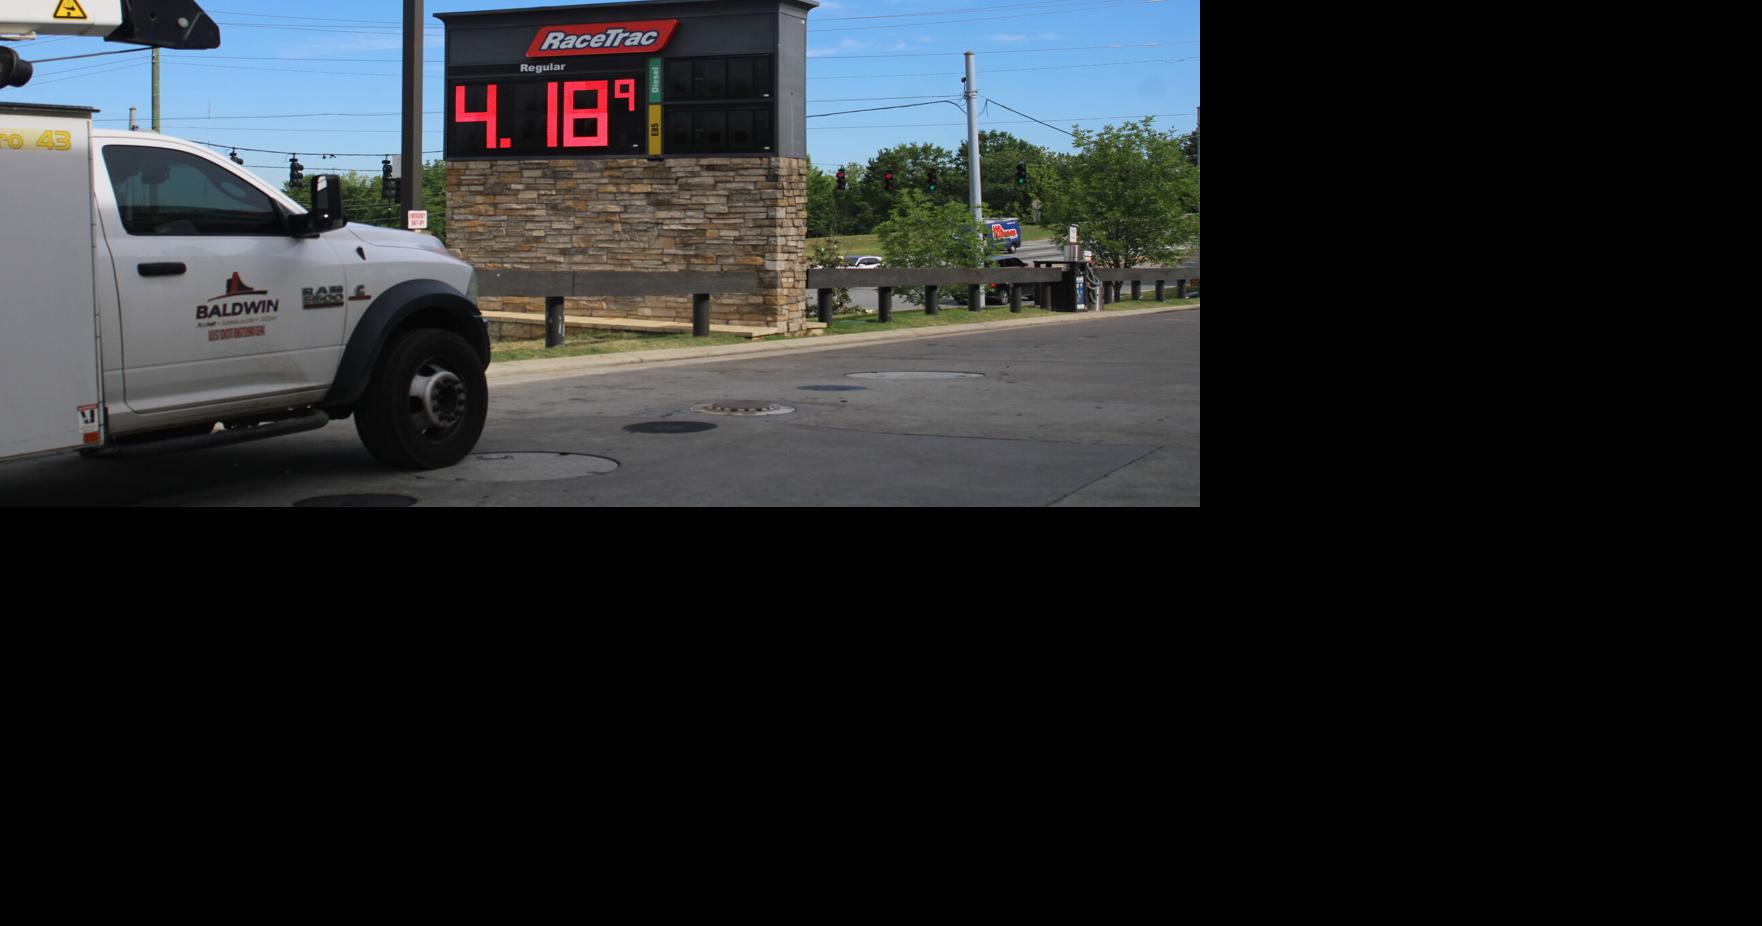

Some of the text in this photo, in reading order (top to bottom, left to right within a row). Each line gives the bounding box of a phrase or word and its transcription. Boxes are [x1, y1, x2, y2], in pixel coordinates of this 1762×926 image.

[540, 29, 659, 50] RaceTrac
[520, 62, 566, 74] Regular
[651, 66, 660, 93] Diesel
[650, 122, 660, 137] E85
[36, 130, 71, 151] 43
[302, 285, 344, 297] RAM
[196, 299, 280, 320] BALDWIN
